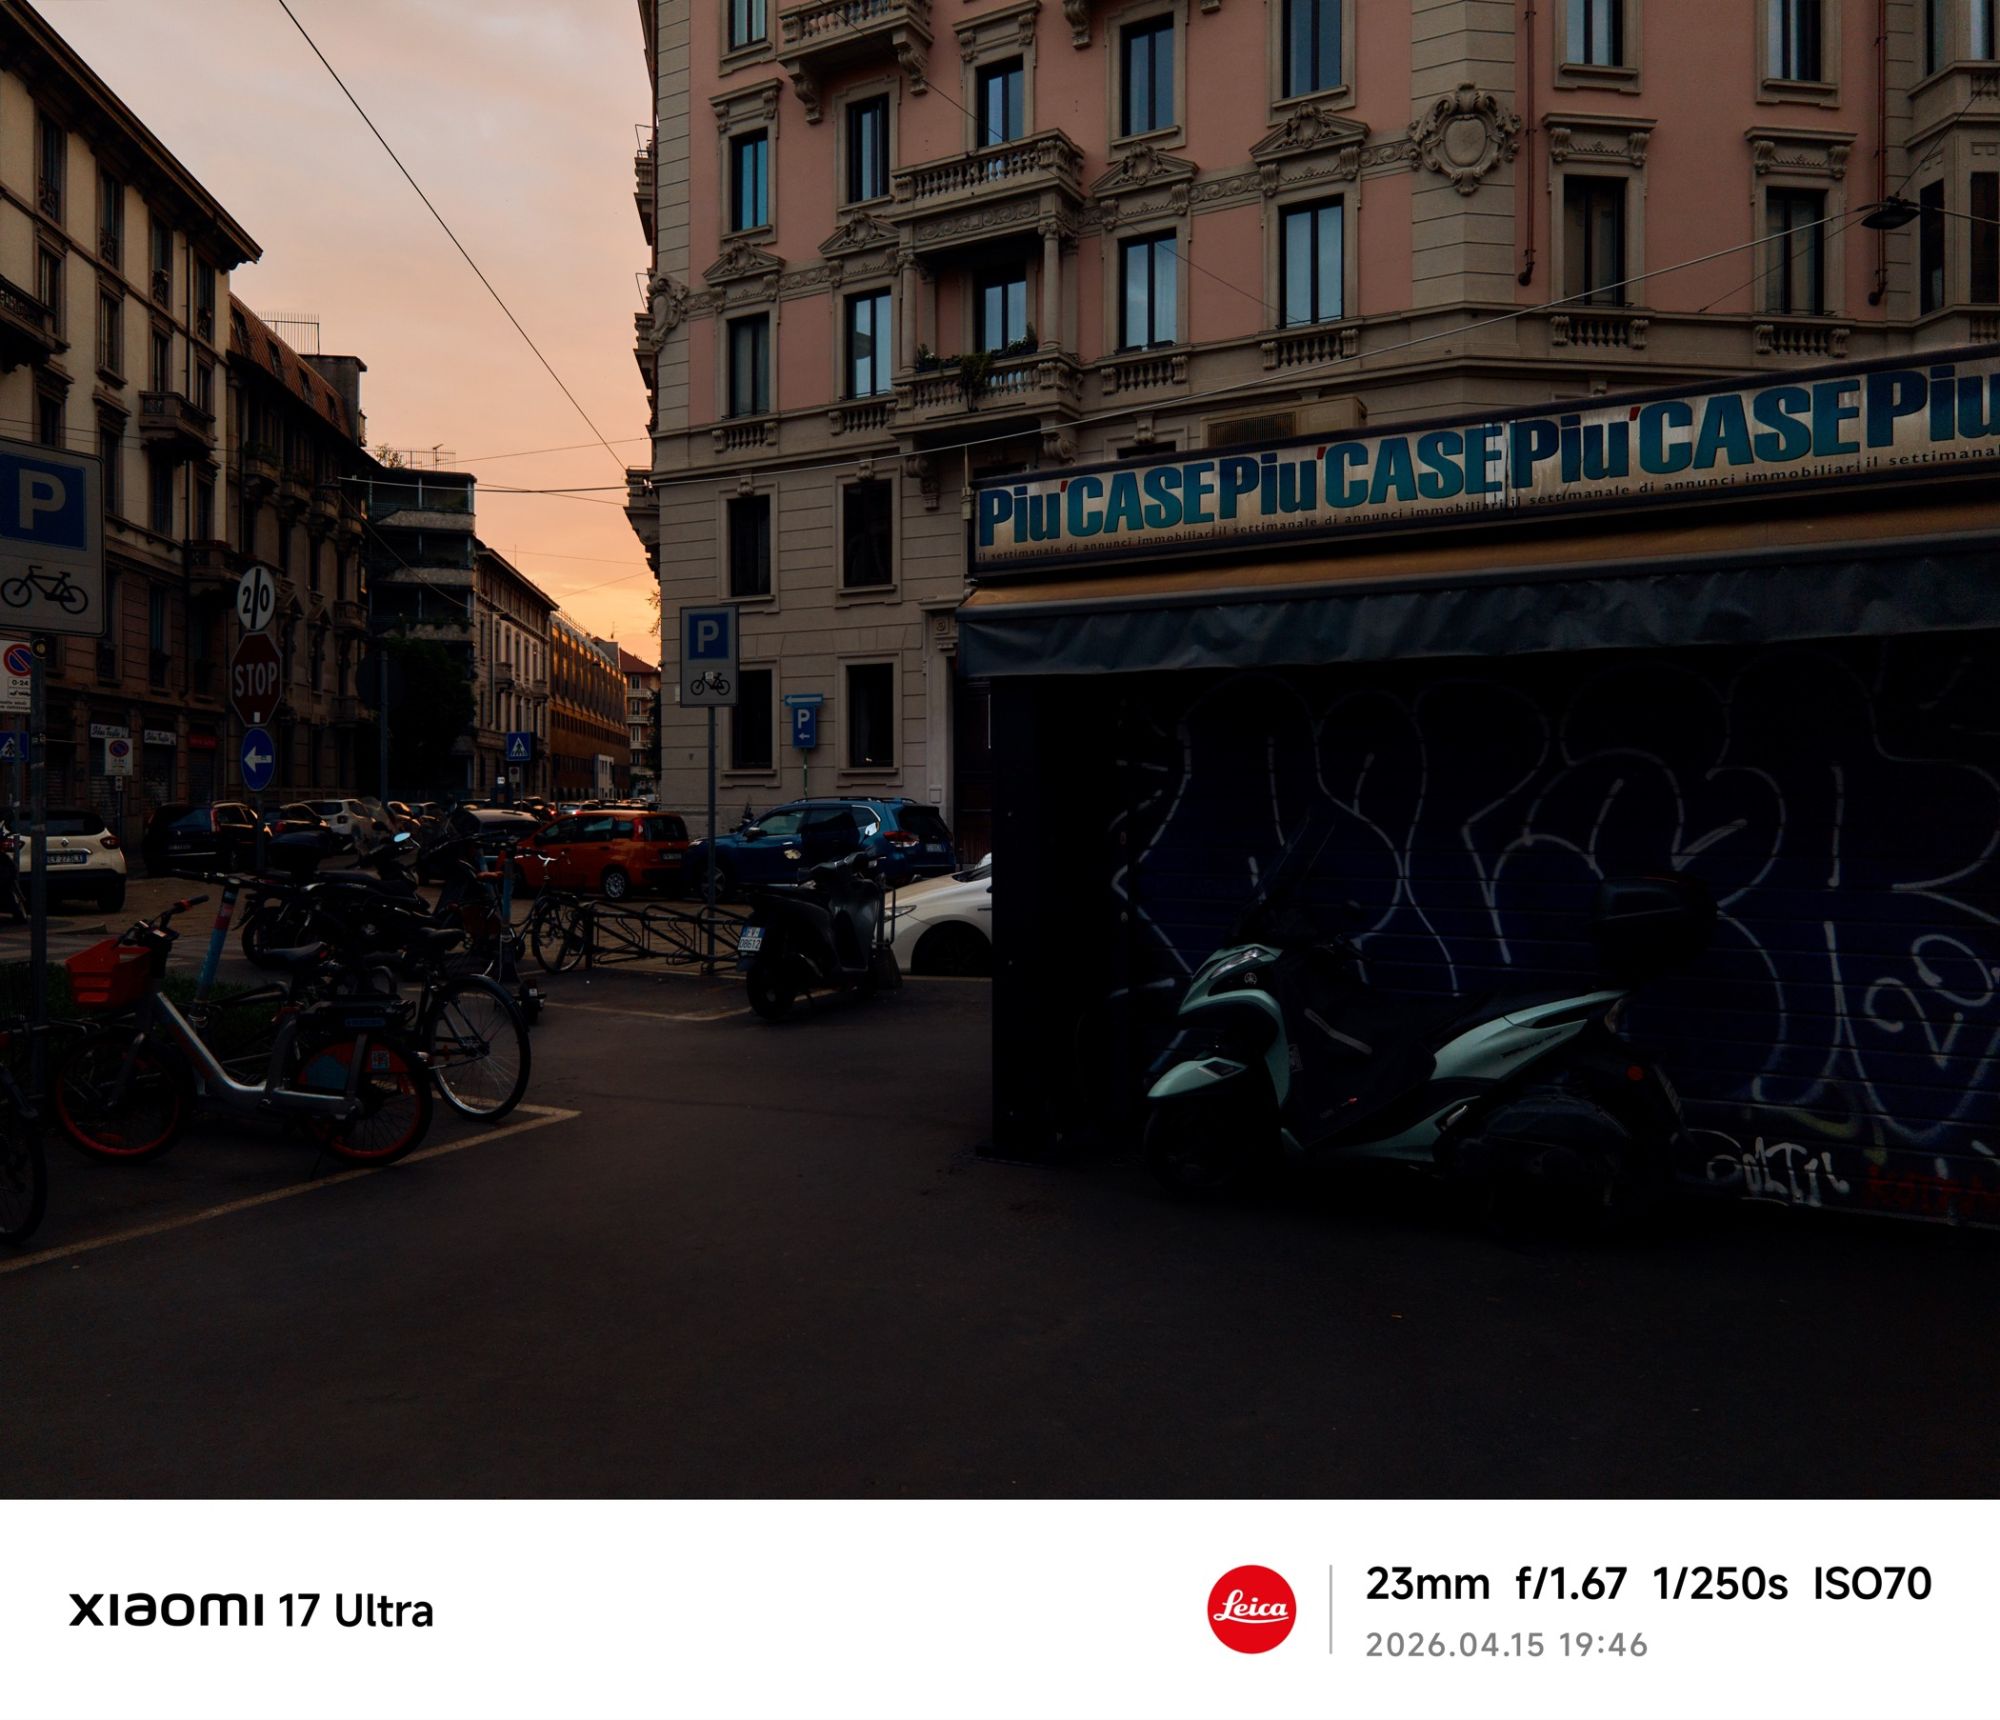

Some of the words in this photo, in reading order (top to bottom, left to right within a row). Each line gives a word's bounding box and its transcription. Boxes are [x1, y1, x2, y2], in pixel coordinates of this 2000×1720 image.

[18, 468, 67, 531] P
[1066, 543, 1078, 554] di
[1083, 538, 1133, 552] annunci
[1138, 526, 1216, 545] immobiliari
[1232, 516, 1318, 535] settimanale
[1324, 514, 1338, 526] di
[1344, 509, 1403, 523] annunci
[1529, 484, 1630, 506] settimanale
[1639, 481, 1656, 495] di
[1663, 474, 1736, 492] annunci
[1745, 461, 1861, 484] immobiliari
[696, 618, 720, 655] P
[233, 661, 279, 699] STOP
[797, 708, 811, 730] P
